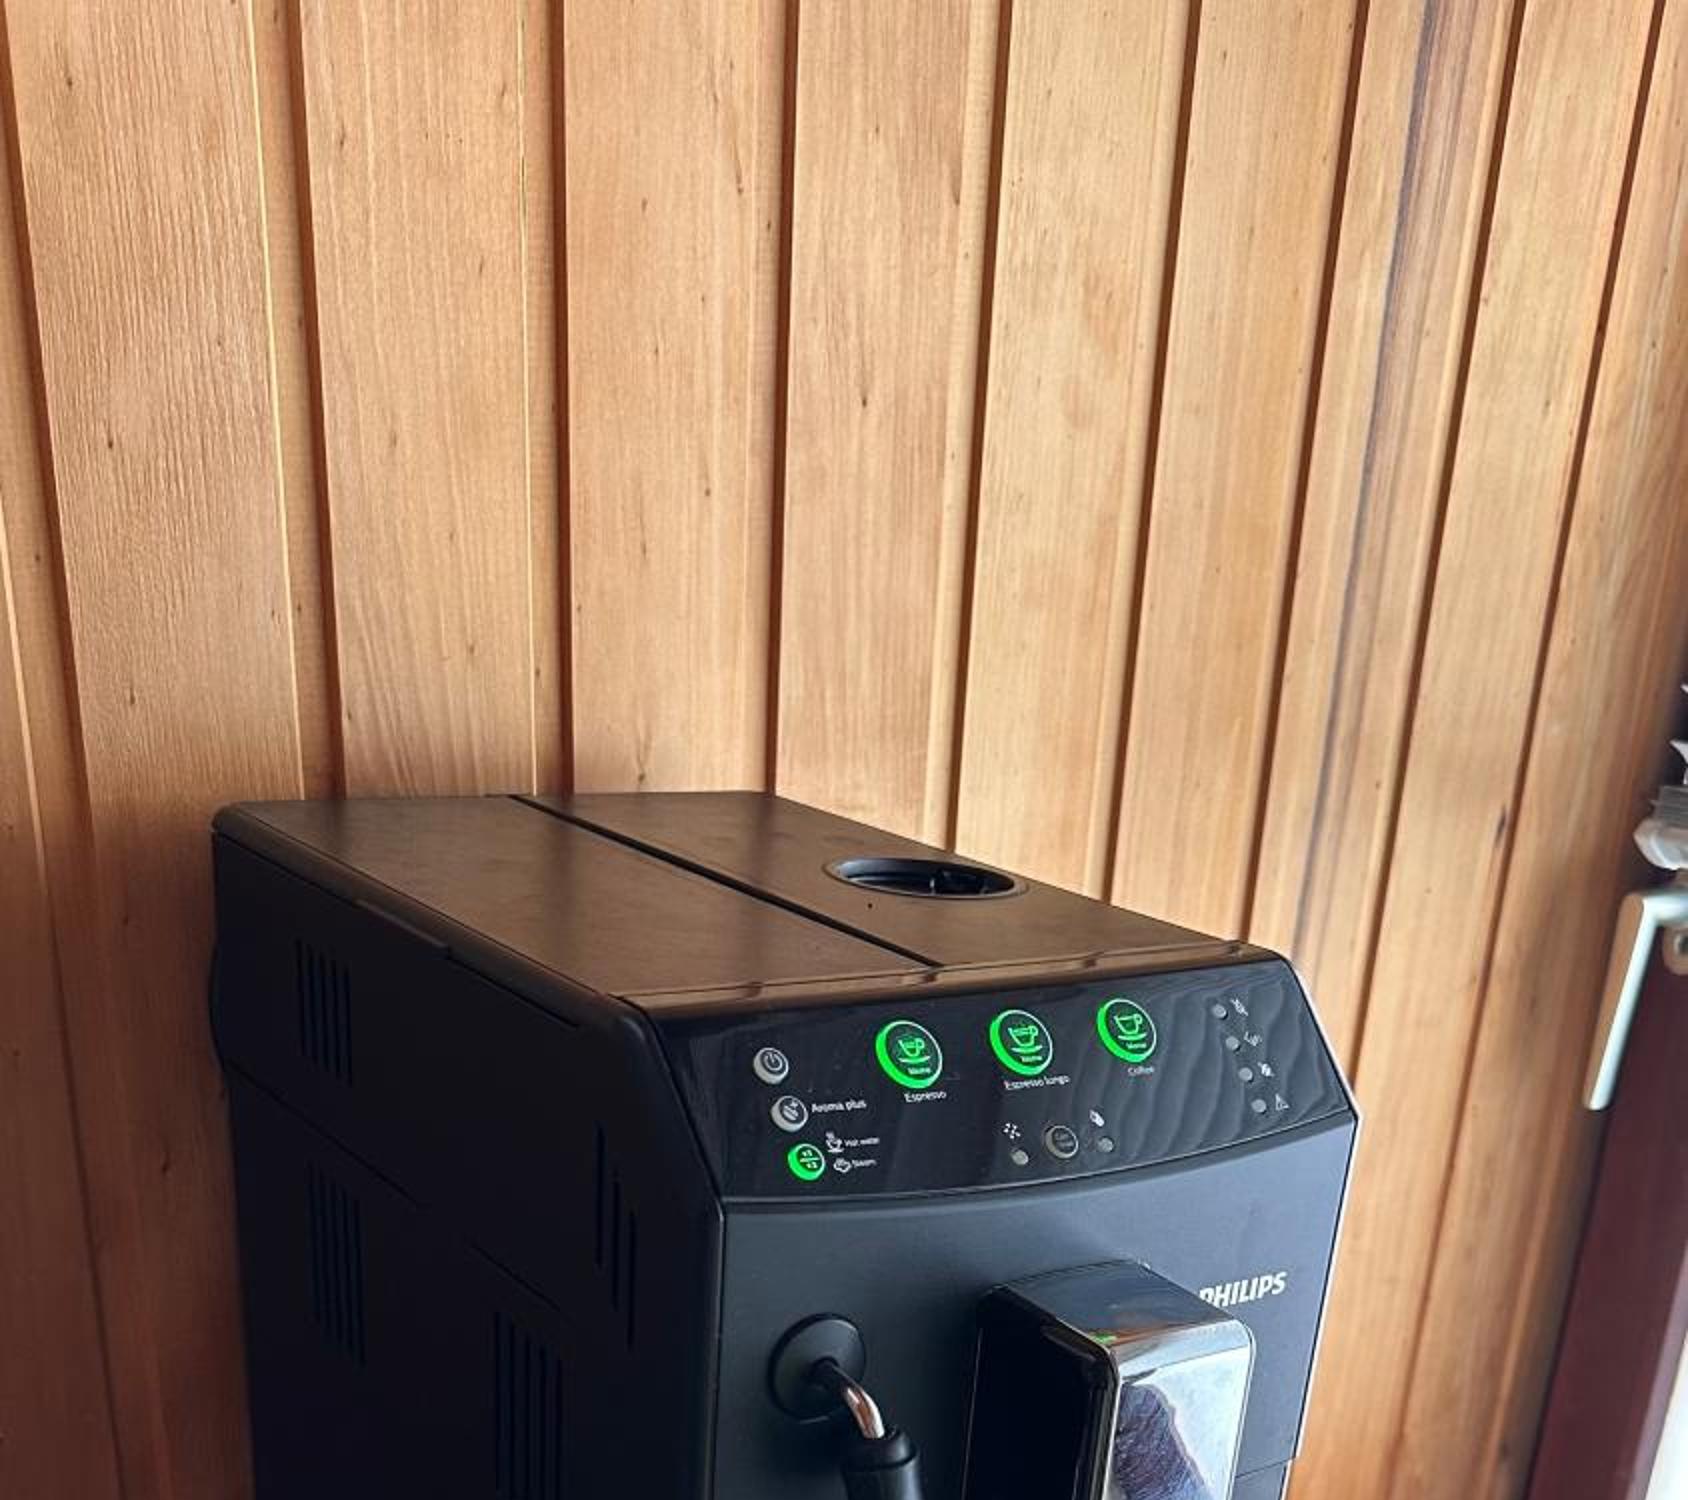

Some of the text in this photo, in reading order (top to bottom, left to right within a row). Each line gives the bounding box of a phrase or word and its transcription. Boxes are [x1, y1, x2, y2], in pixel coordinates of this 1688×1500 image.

[1003, 1080, 1044, 1090] Espresso
[903, 1091, 947, 1103] Espresso
[811, 1098, 867, 1113] Aroma plus
[1199, 1270, 1288, 1309] PHILIPS
